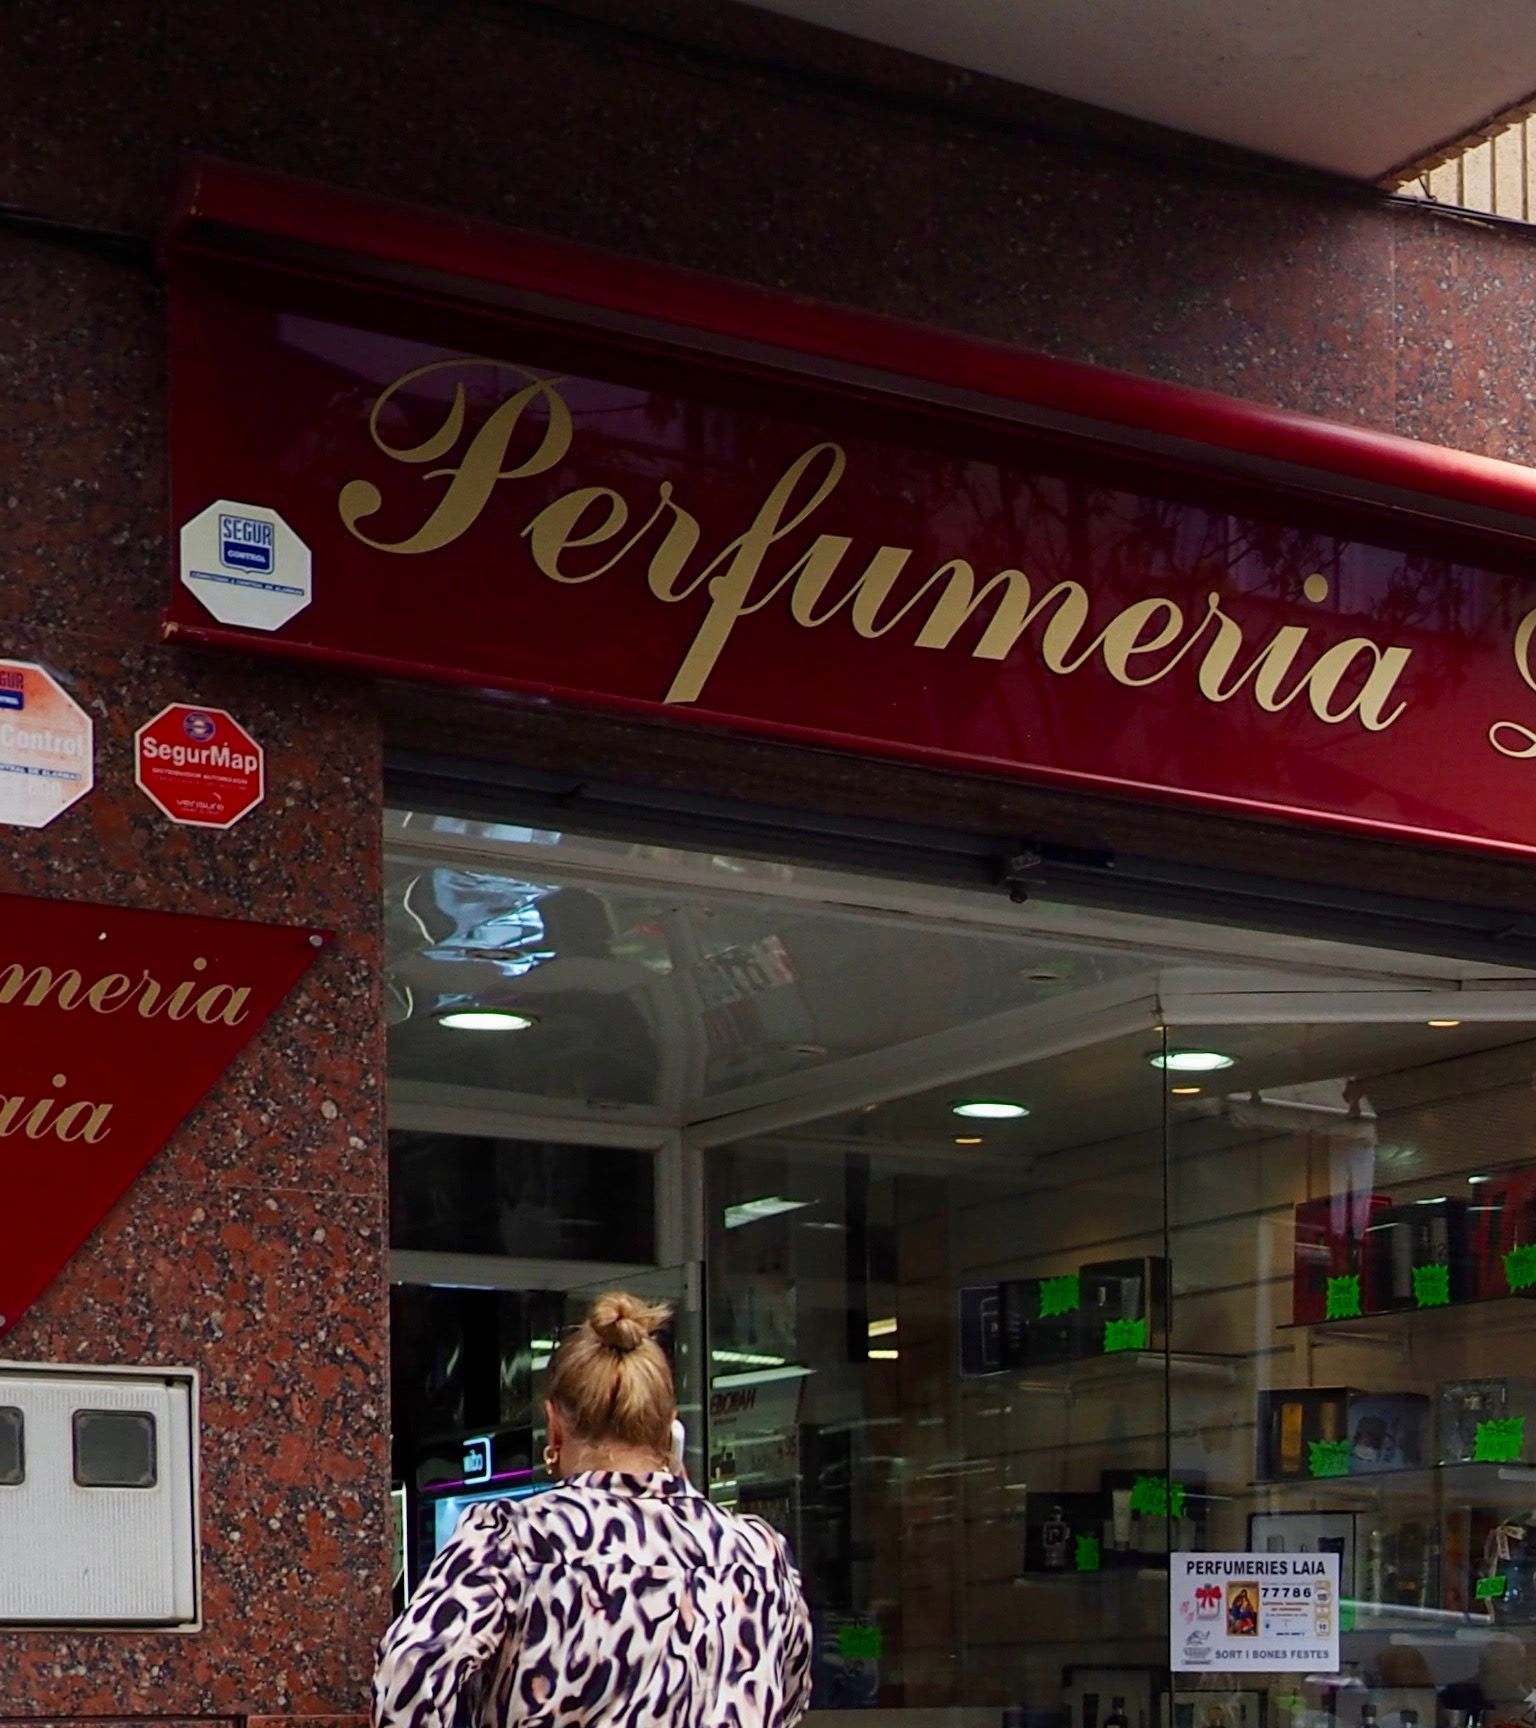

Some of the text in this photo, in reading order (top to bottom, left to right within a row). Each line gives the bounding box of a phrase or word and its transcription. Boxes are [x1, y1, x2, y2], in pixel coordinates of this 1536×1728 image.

[223, 518, 272, 546] SEGUR
[338, 357, 1412, 731] Perfumeria
[142, 737, 258, 774] SegurMap
[1186, 1560, 1326, 1575] PERFUMERIES LAIA
[1261, 1587, 1311, 1599] 77786
[1215, 1650, 1242, 1659] SORT
[1252, 1651, 1287, 1659] BONES
[1291, 1651, 1329, 1659] FESTES
